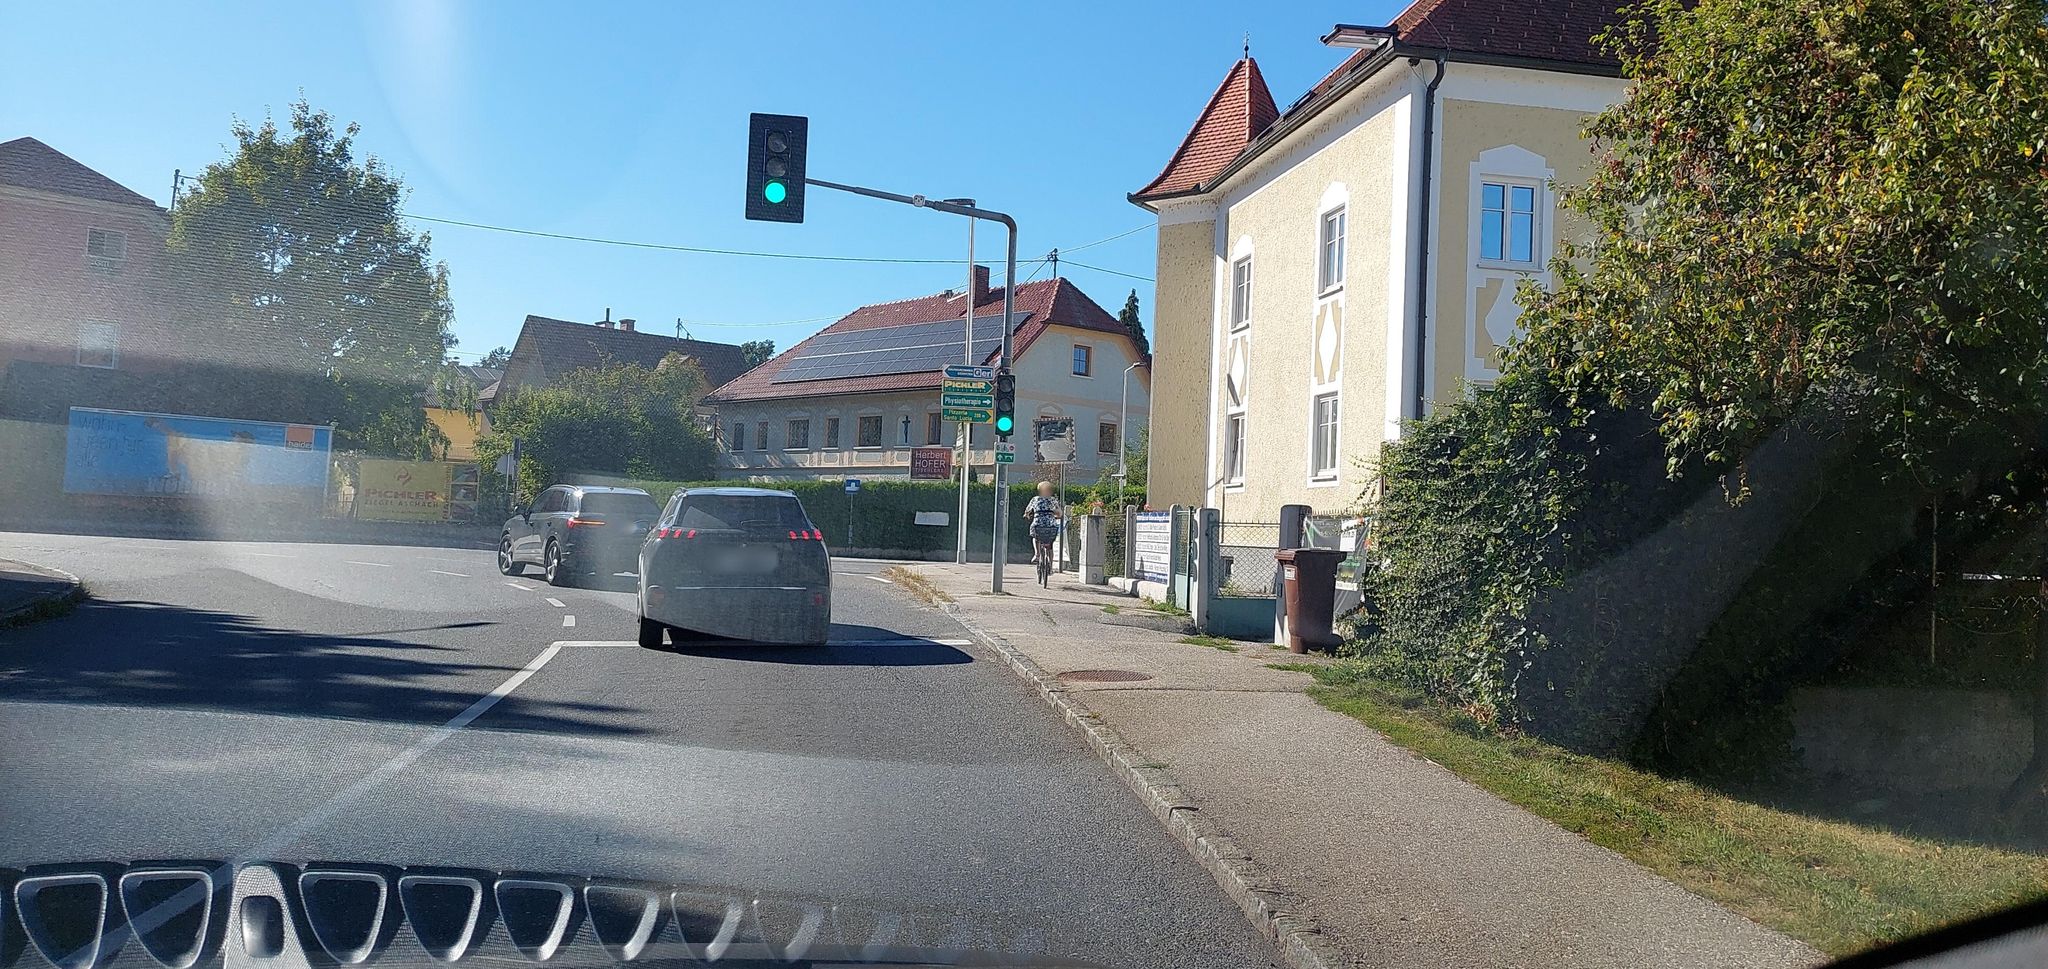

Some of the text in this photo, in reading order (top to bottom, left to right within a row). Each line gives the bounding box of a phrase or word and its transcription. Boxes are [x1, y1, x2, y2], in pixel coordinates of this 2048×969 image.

[944, 380, 986, 389] PICHLER
[915, 450, 946, 459] Herbert
[915, 459, 946, 468] HOFER
[364, 488, 437, 500] PICHLER
[398, 500, 439, 508] ASCHACH
